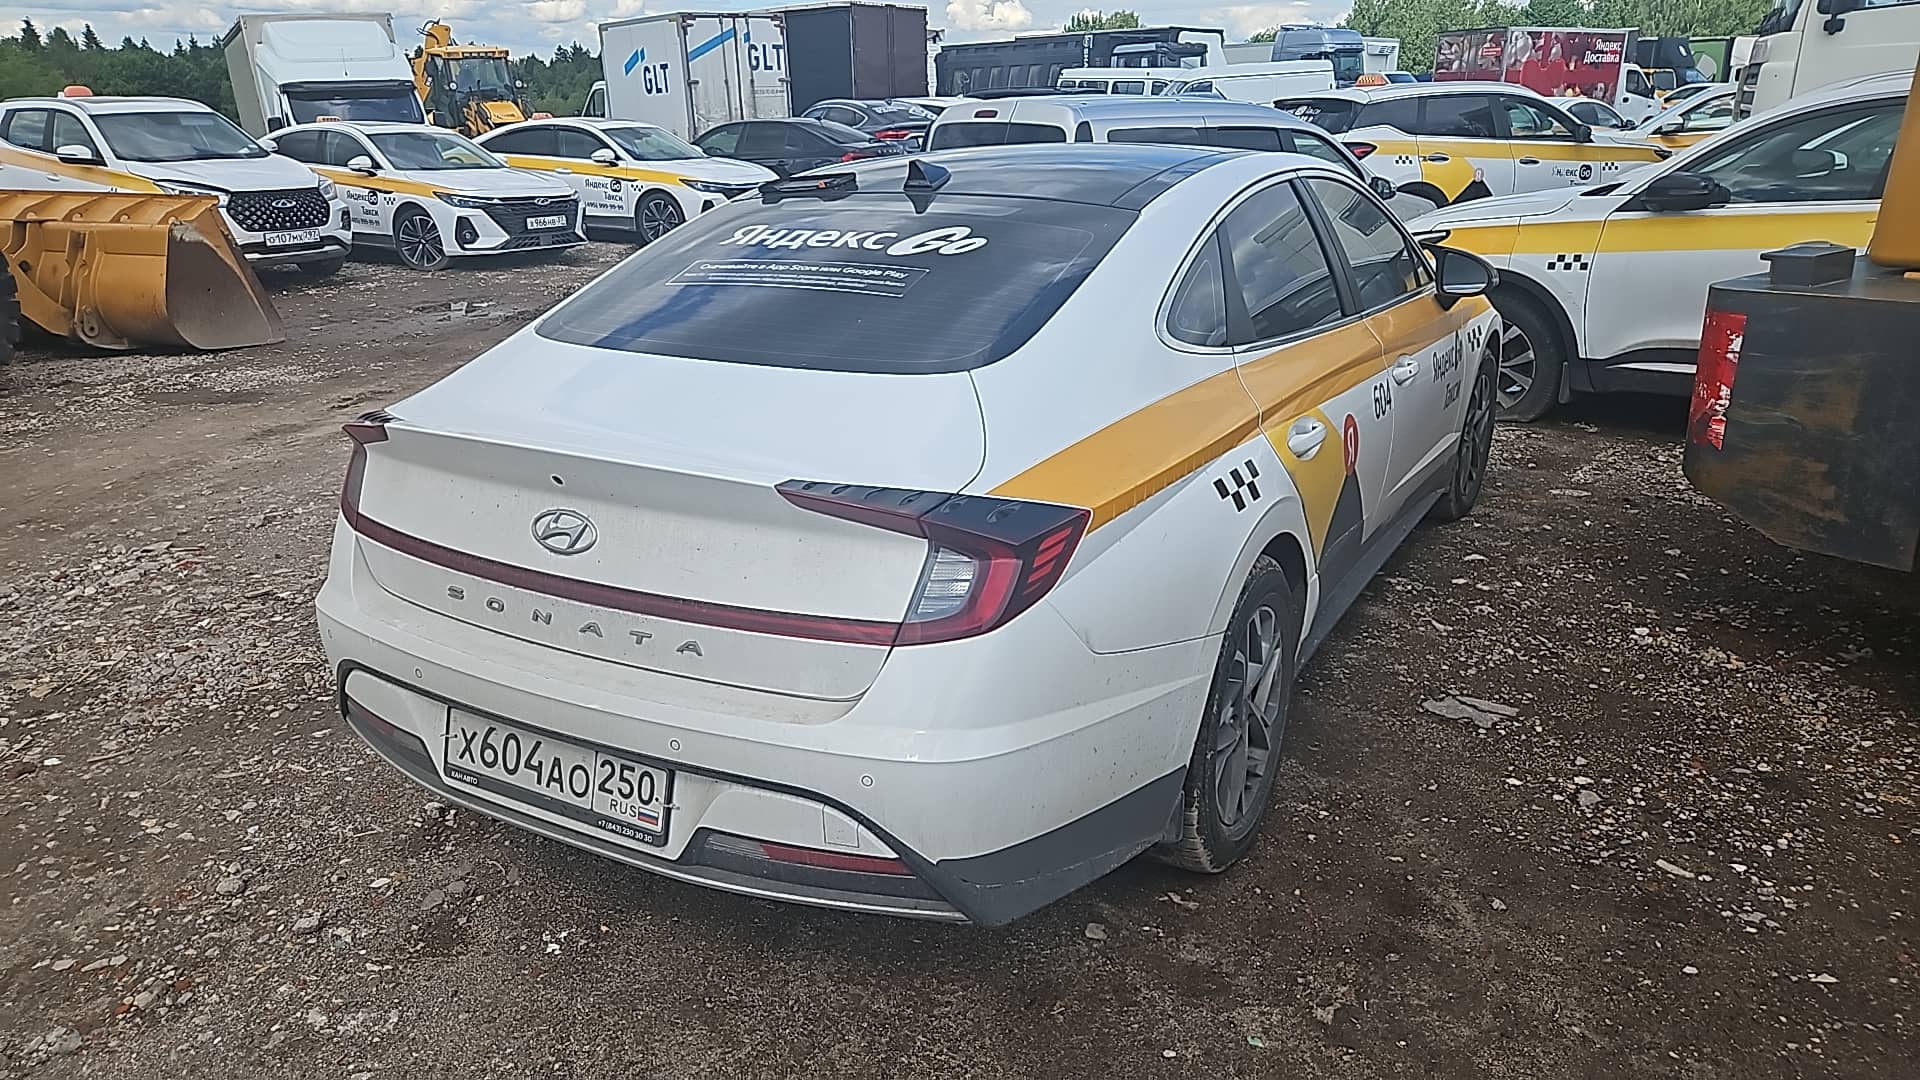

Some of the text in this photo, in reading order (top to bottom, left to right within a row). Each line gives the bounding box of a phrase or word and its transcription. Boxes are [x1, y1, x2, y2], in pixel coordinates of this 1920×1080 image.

[1595, 39, 1623, 51] Яндекс
[748, 44, 784, 71] GLT
[1583, 51, 1620, 64] Доставка
[643, 63, 669, 94] GLT
[1579, 166, 1591, 179] Go
[585, 179, 609, 190] Яндекс
[604, 191, 624, 202] Такси
[719, 225, 988, 255] Яндекс Go
[790, 264, 819, 272] Store
[843, 267, 882, 276] Google
[883, 270, 910, 279] Play
[1373, 379, 1392, 419] 604
[447, 585, 704, 657] SONATA
[457, 726, 656, 805] Х604АО 250
[451, 770, 478, 785] КАН АВТО
[609, 798, 638, 818] RUS
[622, 827, 634, 837] 230
[634, 831, 643, 840] 30
[643, 833, 653, 843] 30
